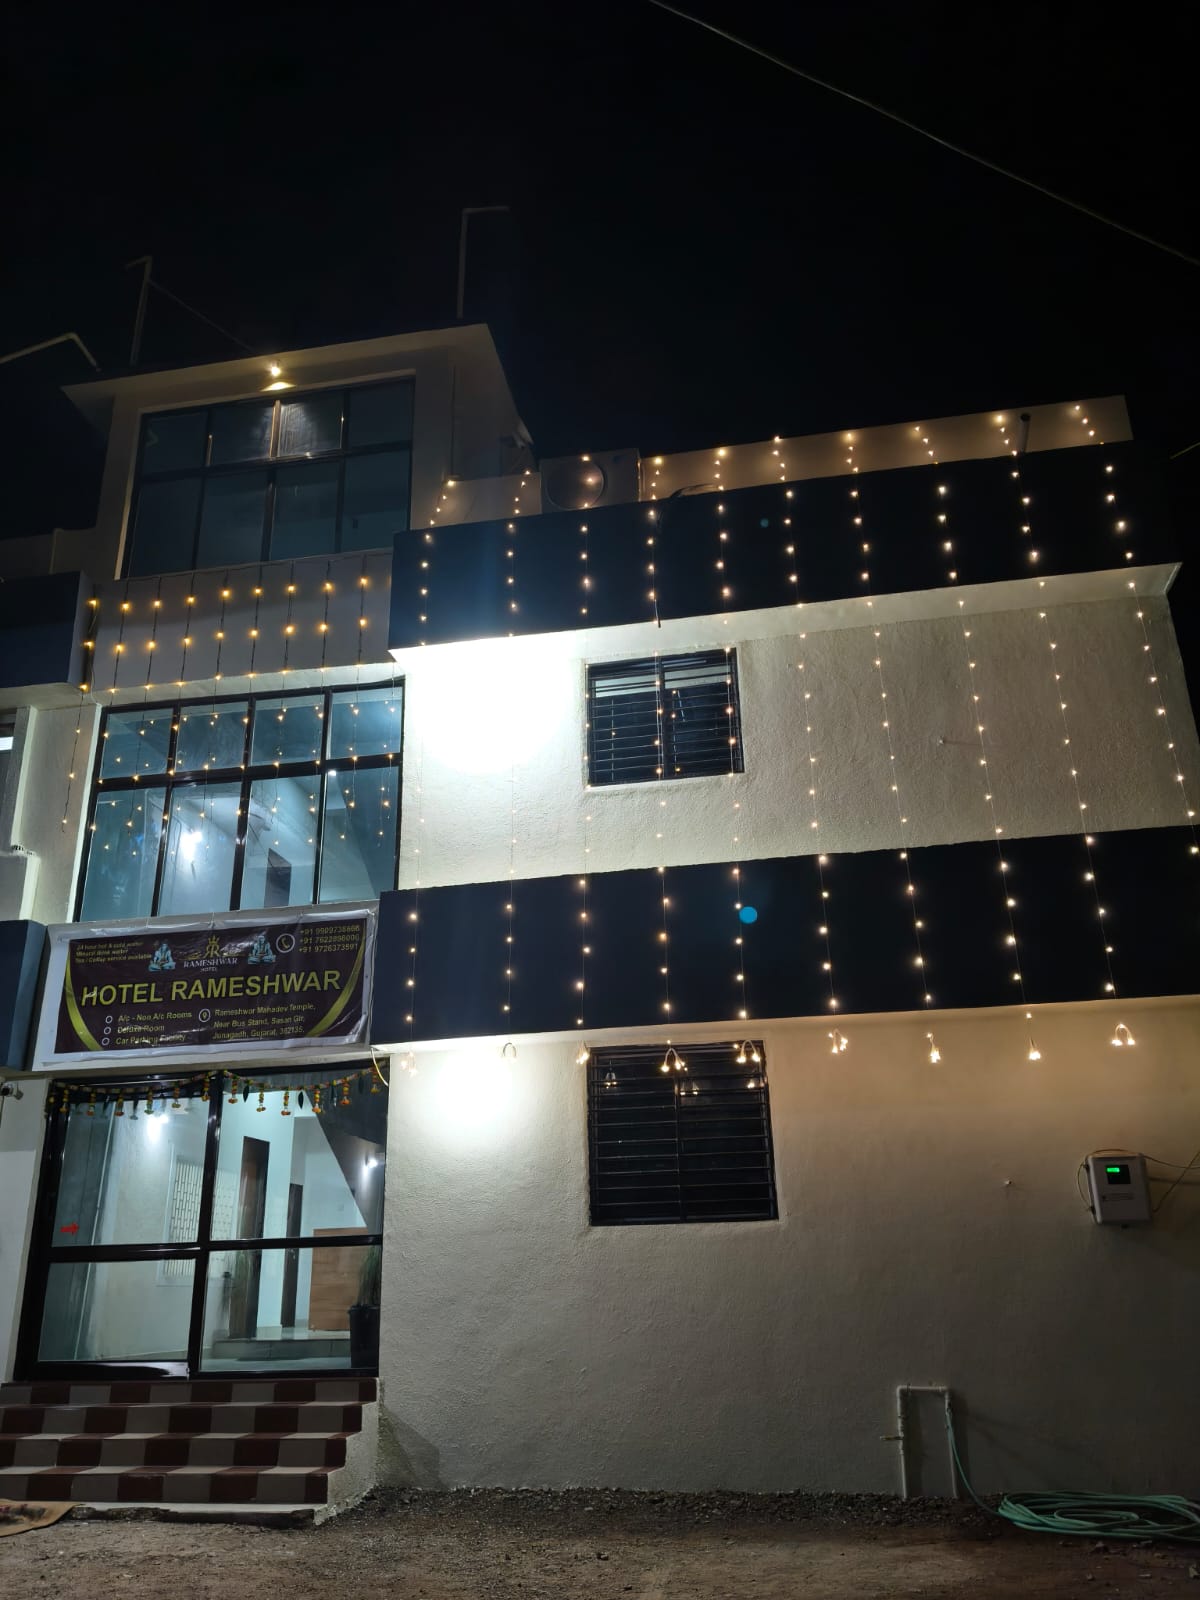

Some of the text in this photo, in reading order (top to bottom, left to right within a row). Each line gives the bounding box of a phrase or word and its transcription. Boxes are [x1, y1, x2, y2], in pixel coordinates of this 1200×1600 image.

[183, 957, 238, 968] RAMESHWAR
[81, 970, 341, 1007] HOTEL RAMESHWAR
[166, 1011, 193, 1019] Rooms
[214, 1007, 256, 1016] Rameshwar
[257, 1005, 288, 1014] Mahadev
[213, 1020, 230, 1029] Near
[232, 1019, 246, 1028] Bus
[115, 1037, 129, 1045] Car
